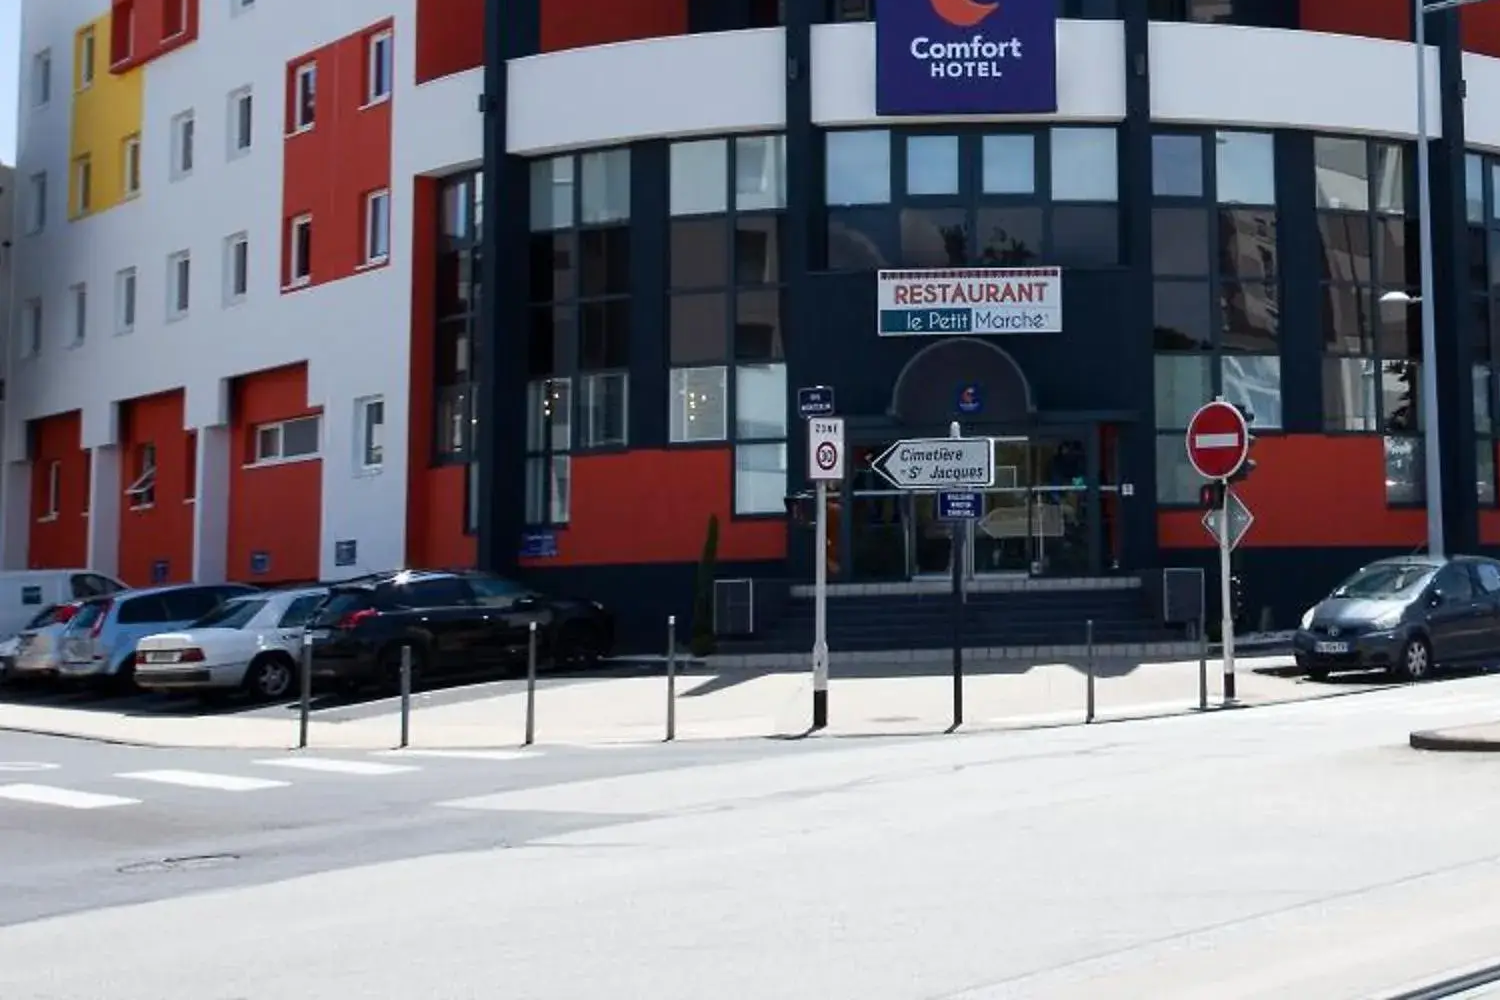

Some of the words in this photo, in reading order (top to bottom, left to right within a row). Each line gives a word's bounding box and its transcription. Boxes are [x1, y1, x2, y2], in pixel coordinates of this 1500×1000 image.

[910, 35, 1022, 59] Comfort
[931, 62, 1002, 77] HOTEL
[894, 282, 1048, 304] RESTAURANT
[907, 312, 922, 330] le
[929, 309, 968, 330] Petit
[929, 465, 983, 480] Jacques
